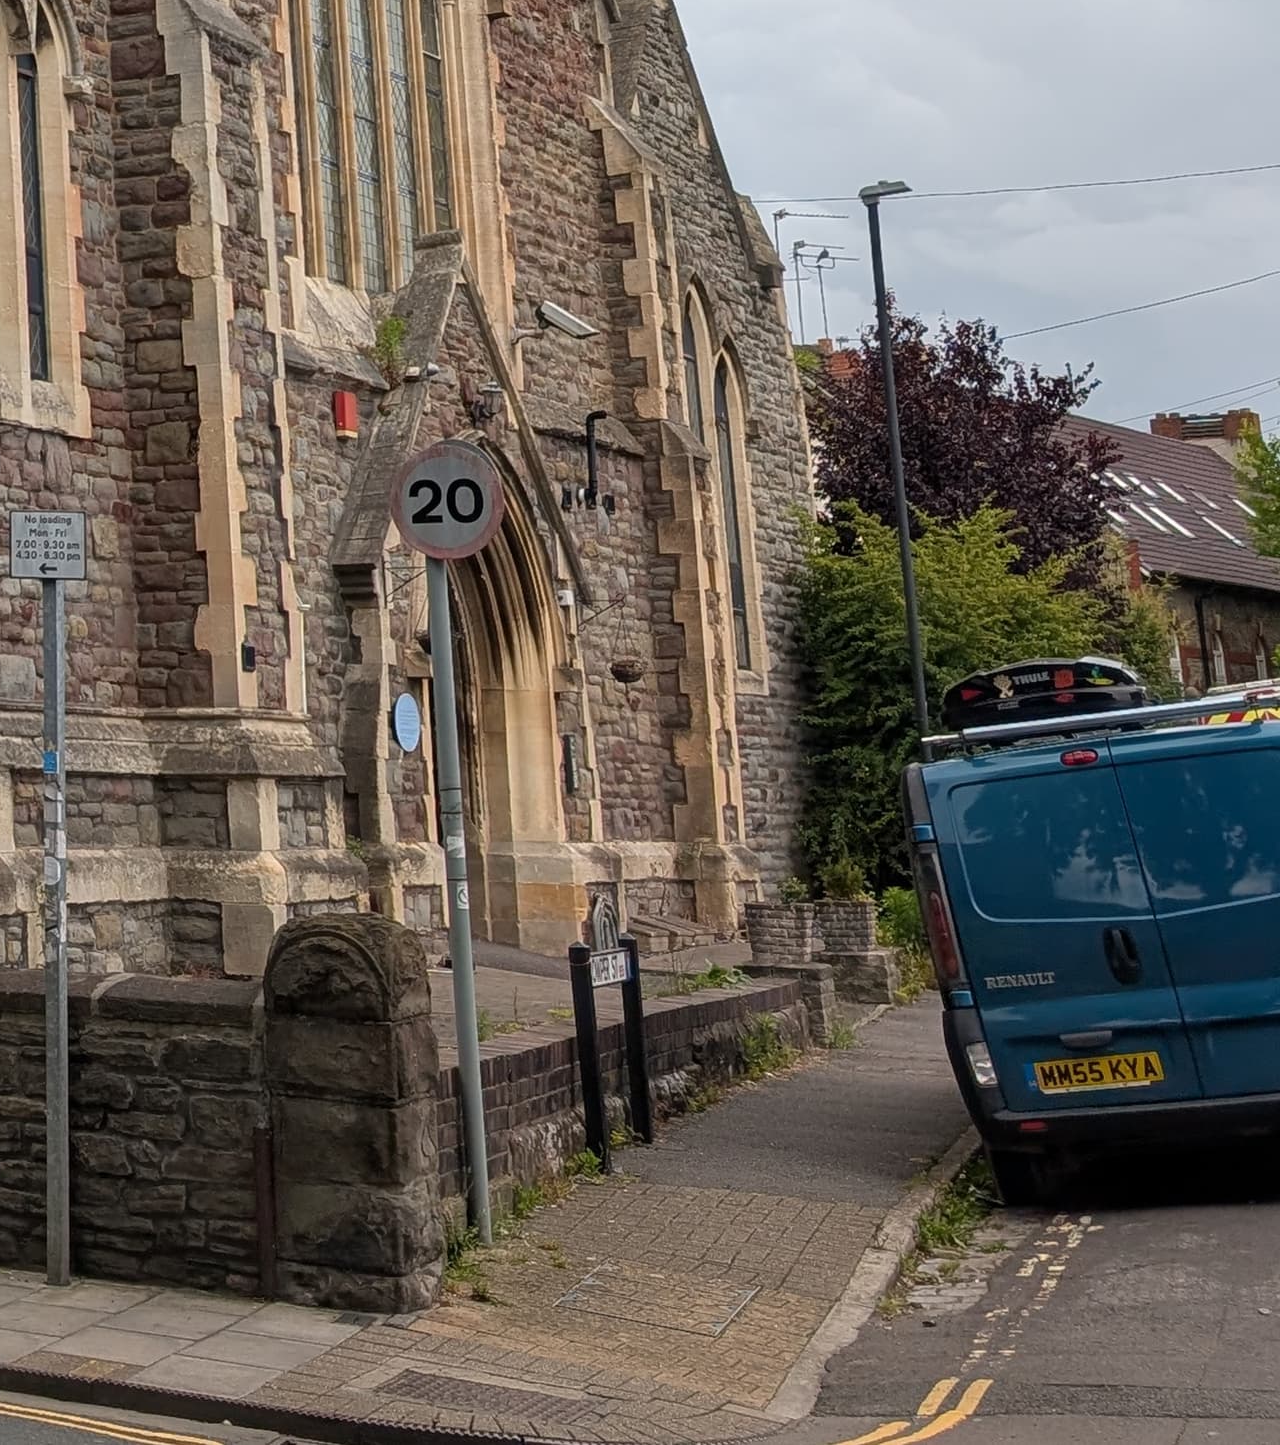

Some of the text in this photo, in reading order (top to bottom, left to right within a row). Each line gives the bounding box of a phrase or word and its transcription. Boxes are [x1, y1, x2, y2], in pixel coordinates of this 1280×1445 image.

[408, 478, 484, 524] 20
[24, 515, 72, 526] No loading
[29, 528, 48, 537] Mon
[55, 528, 67, 537] Fri
[15, 540, 37, 549] 7.00
[43, 540, 65, 550] 9.30
[66, 542, 80, 550] am
[15, 550, 37, 560] 4.30
[43, 551, 65, 560] 6.30
[66, 553, 81, 562] pm
[1012, 671, 1050, 686] THULE
[984, 972, 1056, 990] RENAULT
[1040, 1056, 1159, 1087] MM55 KYA
